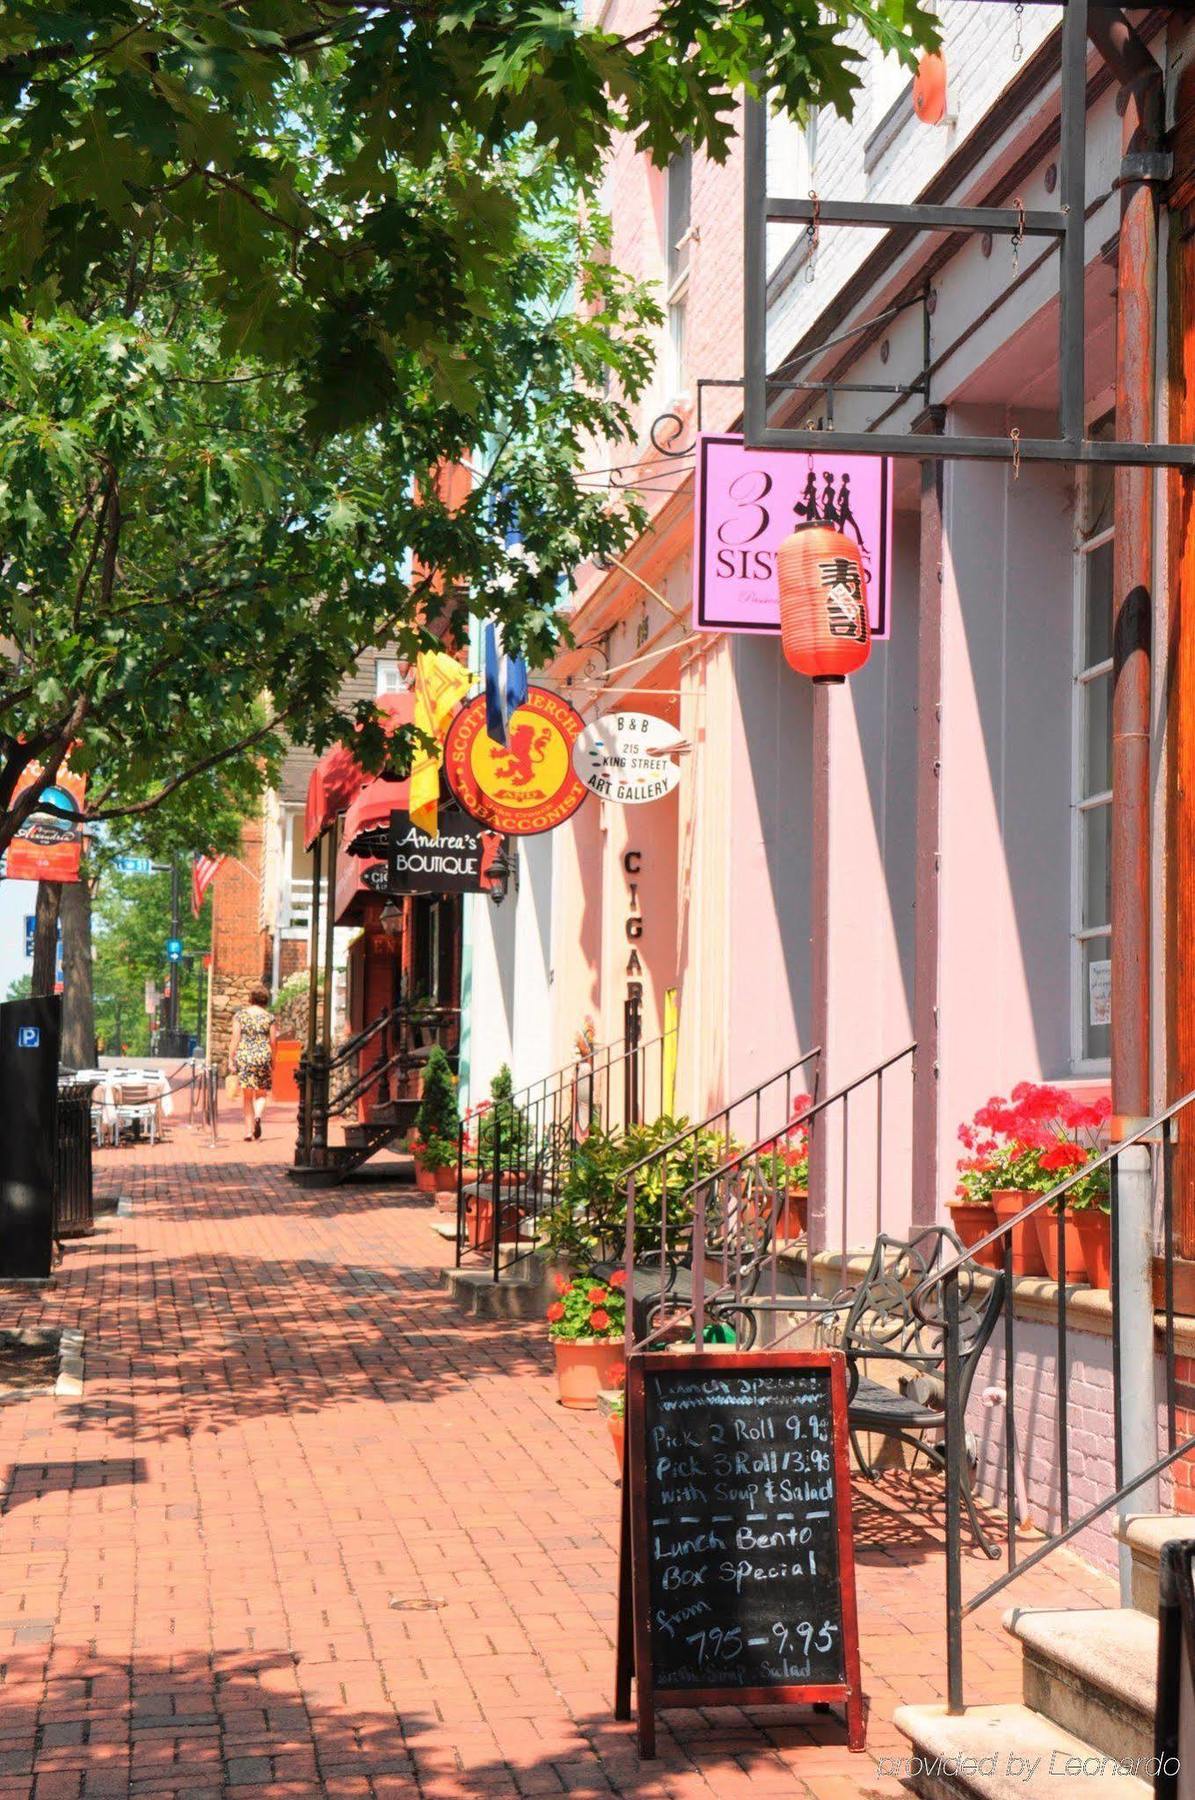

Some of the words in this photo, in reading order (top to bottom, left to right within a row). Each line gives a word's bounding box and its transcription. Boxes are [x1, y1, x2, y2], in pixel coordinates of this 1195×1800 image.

[717, 470, 773, 546] 3
[617, 717, 625, 731] B
[628, 718, 637, 731] &
[640, 720, 649, 733] B
[623, 744, 640, 755] 215
[603, 756, 627, 768] KING
[631, 758, 668, 770] STREET
[587, 774, 613, 795] ART
[617, 778, 669, 800] GALLERY
[457, 783, 582, 831] TOBACCONIST
[396, 827, 478, 850] Andrea's
[397, 855, 478, 875] BOUTIQUE
[24, 1030, 35, 1044] P
[653, 1424, 703, 1450] Pick
[709, 1424, 729, 1443] 2
[735, 1416, 774, 1441] Roll
[656, 1455, 706, 1480] Pick
[713, 1453, 732, 1476] 3
[735, 1450, 777, 1475] Roll
[661, 1483, 708, 1504] with
[714, 1482, 759, 1510] Soup
[780, 1478, 834, 1502] Salad
[654, 1530, 727, 1560] Lunch
[736, 1526, 812, 1550] Bento
[662, 1565, 708, 1590] Box
[772, 1620, 838, 1657] 9.95
